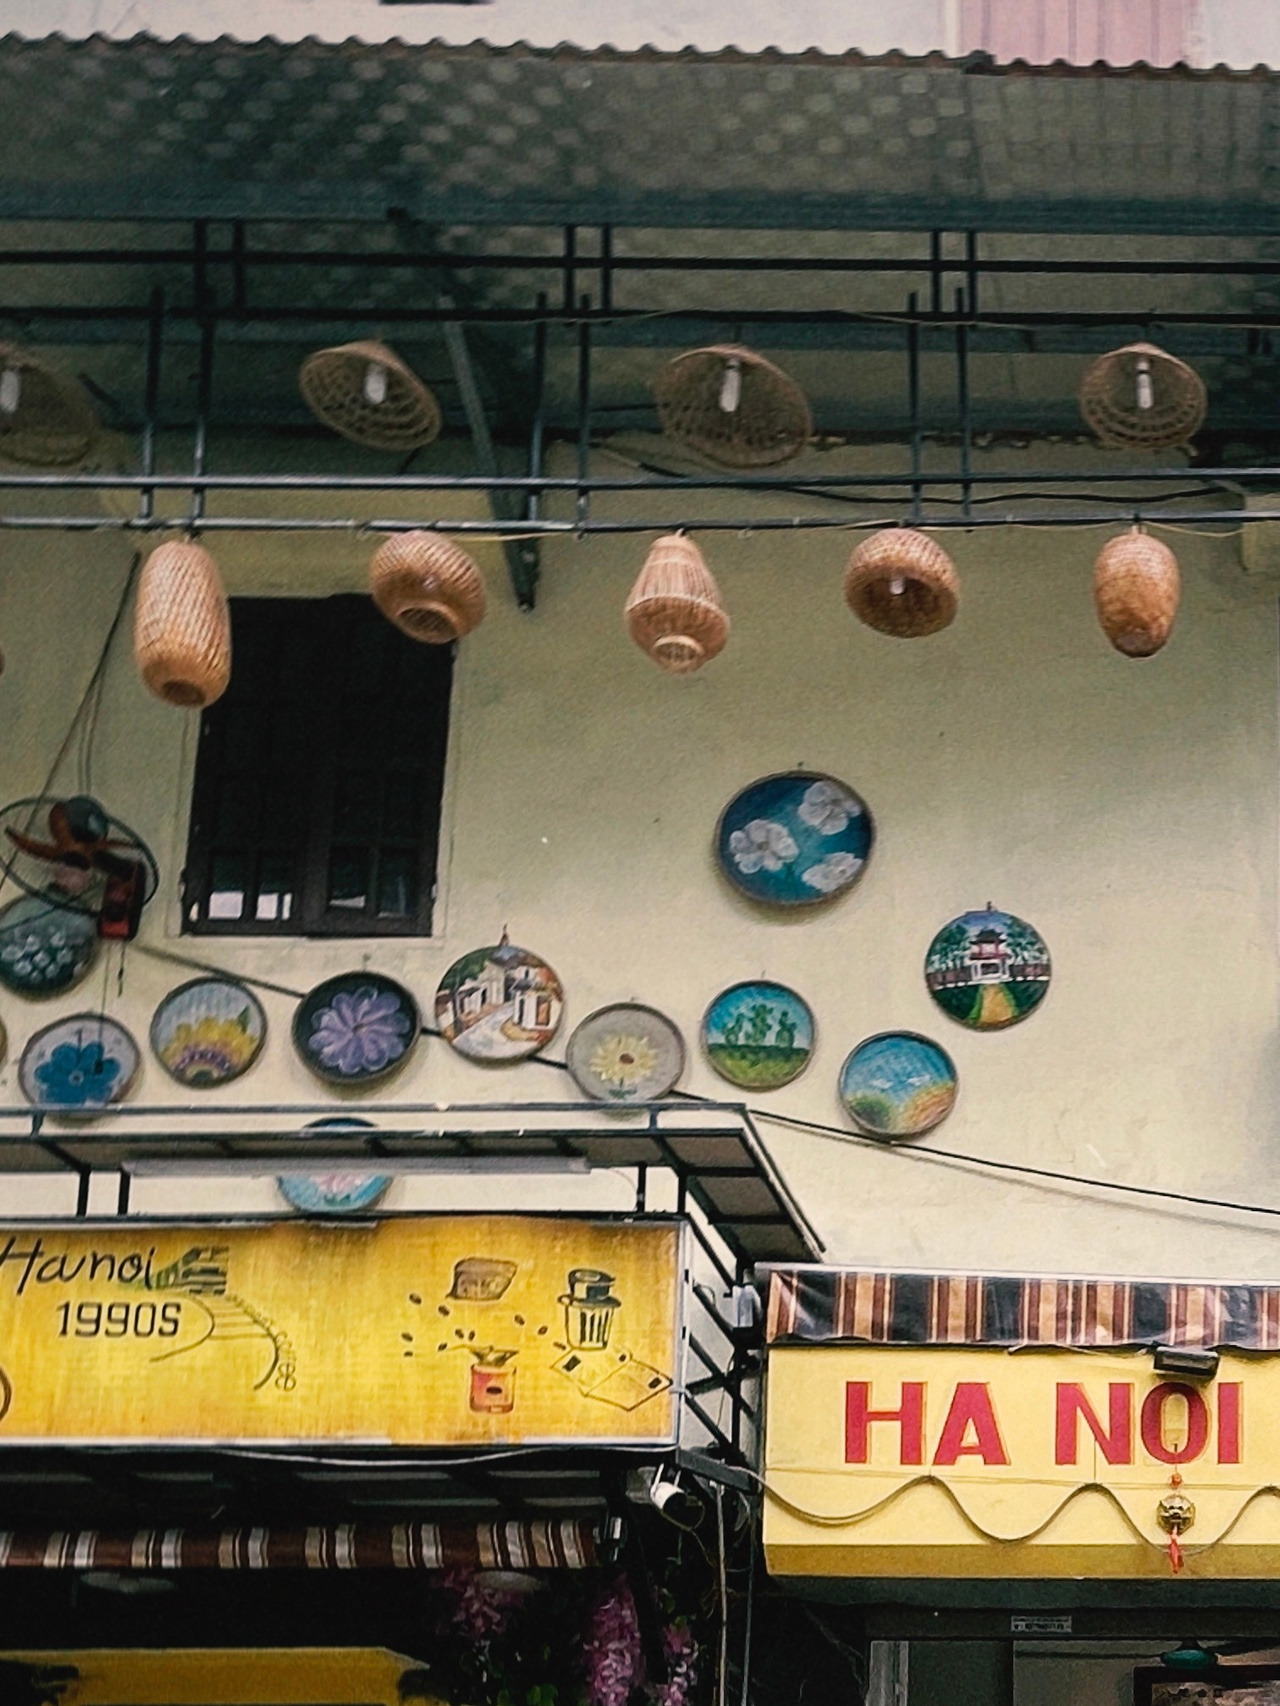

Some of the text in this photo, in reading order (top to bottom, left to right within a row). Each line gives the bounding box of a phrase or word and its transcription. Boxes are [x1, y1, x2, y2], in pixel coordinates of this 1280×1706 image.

[0, 1235, 155, 1296] Hanoi
[56, 1301, 182, 1338] 1990S
[844, 1381, 1010, 1466] HA
[1054, 1381, 1246, 1466] NOI
